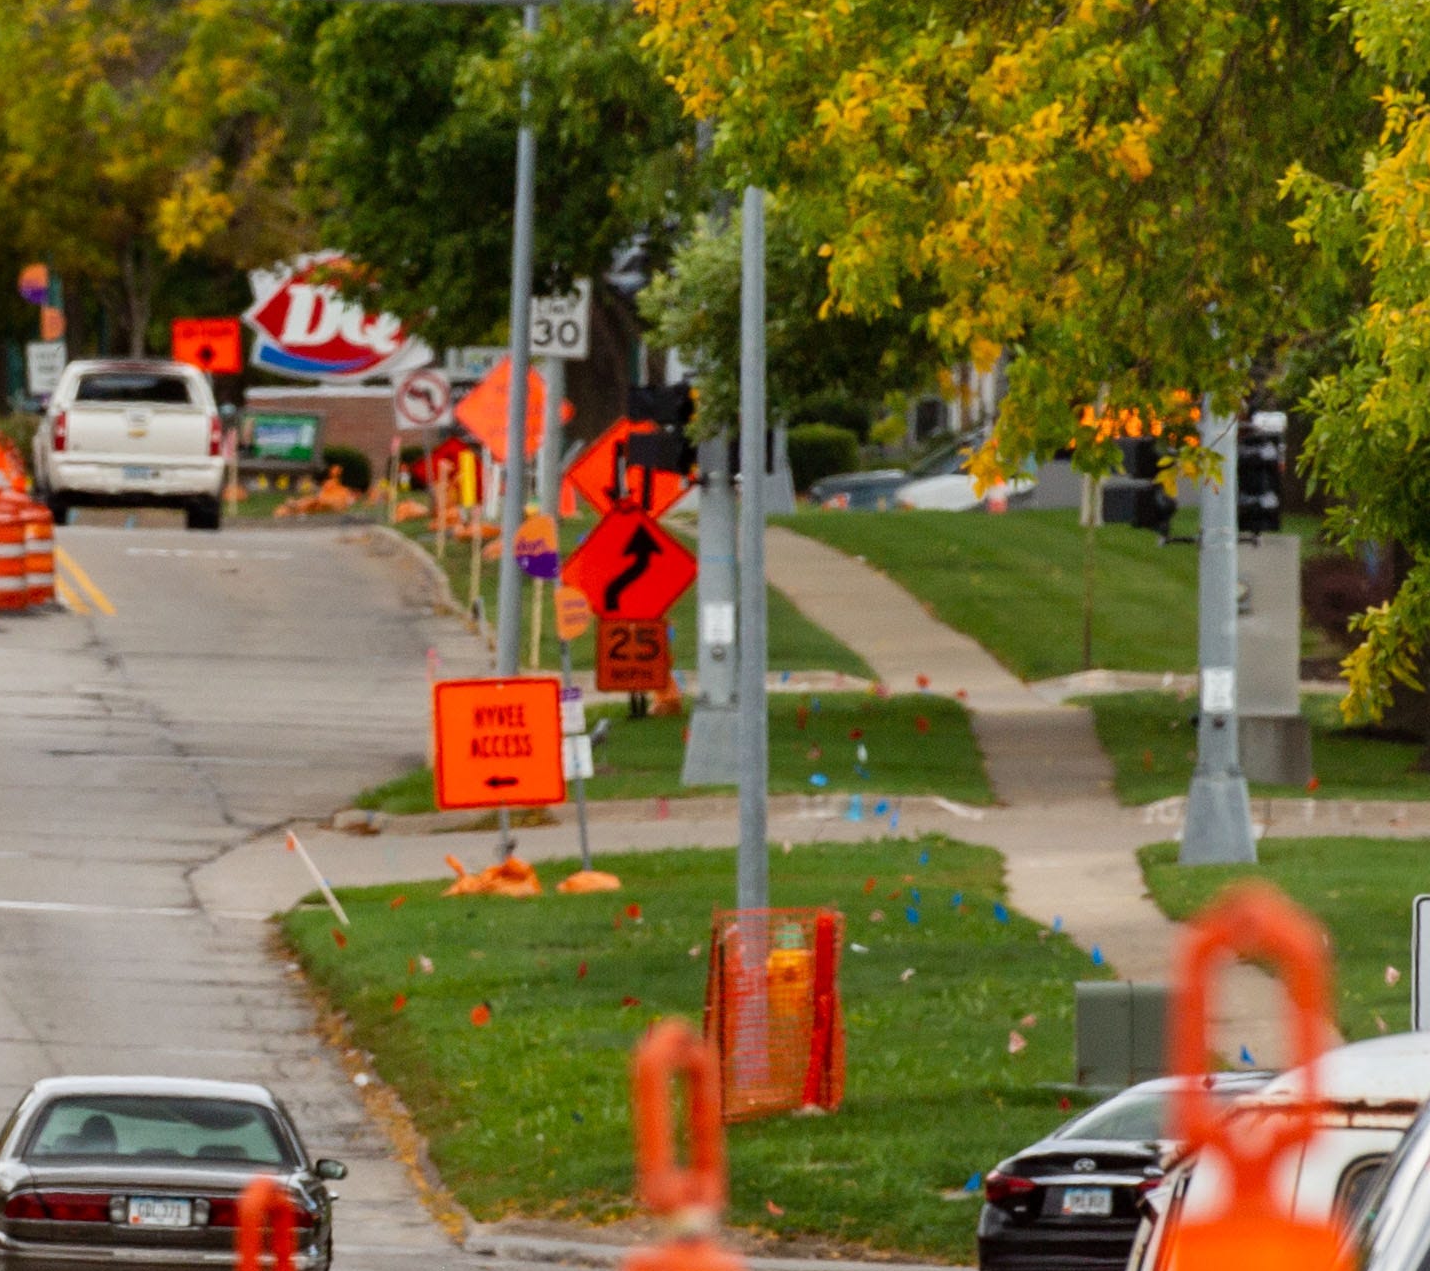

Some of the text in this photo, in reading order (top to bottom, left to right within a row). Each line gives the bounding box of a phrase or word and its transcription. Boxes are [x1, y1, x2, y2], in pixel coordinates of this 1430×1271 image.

[533, 318, 581, 348] 30
[609, 627, 660, 661] 25
[470, 734, 533, 759] ACCESS
